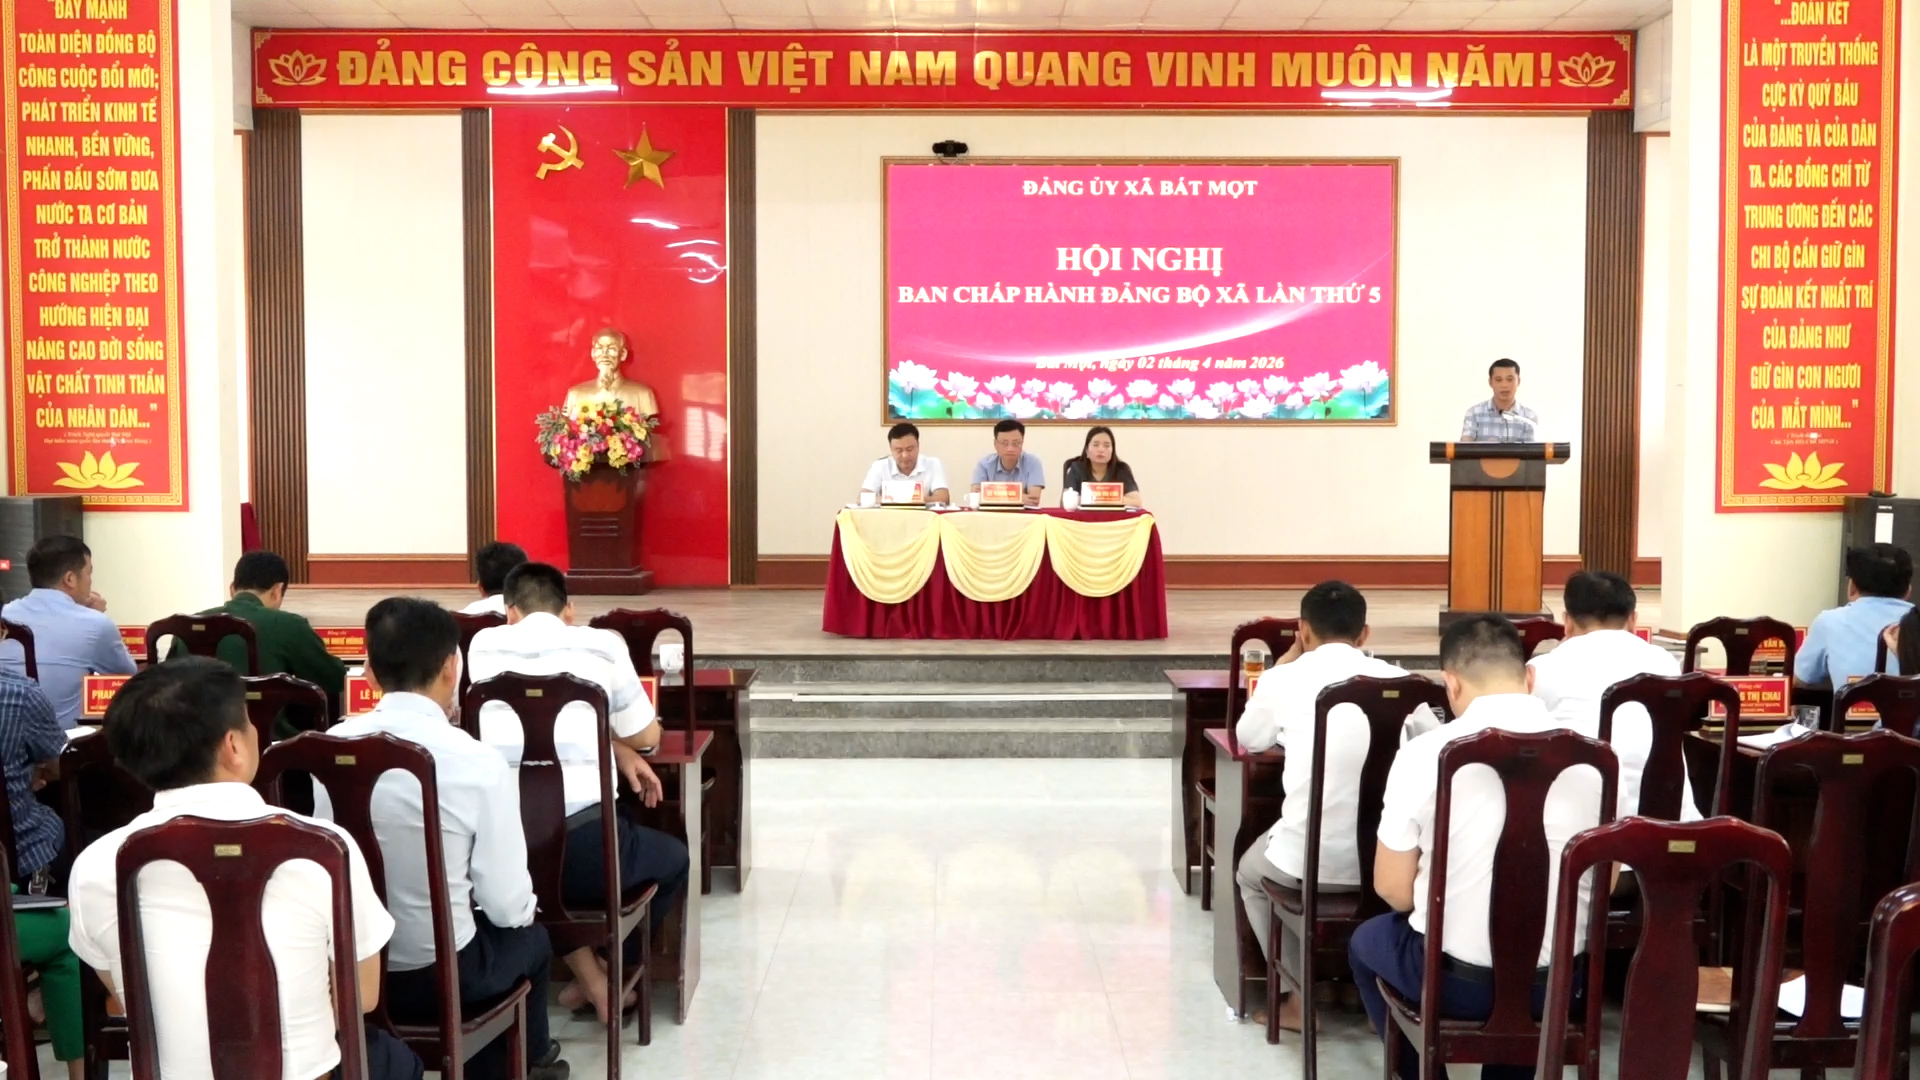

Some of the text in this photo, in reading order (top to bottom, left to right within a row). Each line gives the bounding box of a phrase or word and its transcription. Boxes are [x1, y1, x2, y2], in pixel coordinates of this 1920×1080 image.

[20, 30, 55, 53] TOÀN
[60, 30, 92, 57] DIỆN
[138, 30, 156, 57] BỘ
[1744, 38, 1758, 66] LÀ
[1762, 38, 1787, 71] MỘT
[1839, 34, 1878, 65] THỐNG
[19, 61, 158, 92] CÔNG CUỘC ĐỔI MỚI;
[336, 38, 468, 87] ĐẢNG
[485, 45, 613, 87] CÔNG
[627, 38, 724, 87] SẢN
[736, 42, 834, 94] VIỆT
[851, 50, 957, 86] NAM
[975, 51, 1132, 91] QUANG
[1146, 51, 1256, 87] VINH
[1271, 44, 1414, 87] MUÔN
[22, 95, 157, 122] PHÁT TRIỂN KINH TẾ
[1762, 78, 1858, 112] CỰC KỲ QUÝ BÁU
[26, 130, 154, 158] NHANH, BỀN VỮNG,
[1743, 116, 1876, 147] CỦA ĐẢNG VÀ CỦA DÂN
[23, 164, 159, 190] PHẤN ĐẤU SỚM ĐƯA
[1749, 157, 1871, 188] TA. CÁC ĐỒNG CHÍ TỪ
[1023, 176, 1258, 200] ĐẢNG ỦY XÃ BÁT MỌT
[36, 198, 147, 224] NƯỚC TA CƠ BẢN
[1744, 198, 1872, 228] TRUNG ƯƠNG ĐẾN CÁC
[34, 232, 150, 259] TRỞ THÀNH NƯỚC
[1751, 237, 1864, 274] CHI BỘ CẦN GIỮ GÌN
[1056, 244, 1224, 277] HỘI NGHỊ
[29, 269, 158, 297] CÔNG NGHIỆP THEO
[898, 282, 1380, 308] BAN CHẤP HÀNH ĐẢNG BỘ XÃ LẦN THỨ 5
[1742, 278, 1873, 314] SỰ ĐOÀN KẾT NHẤT TRÍ
[40, 303, 149, 331] HƯỚNG HIỆN ĐẠI
[27, 334, 164, 360] NÂNG CAO ĐỜI SỐNG
[1763, 318, 1851, 349] CỦA ĐẢNG NHƯ
[1100, 358, 1135, 372] ngày
[1137, 357, 1154, 369] 02
[1157, 357, 1200, 372] tháng
[1202, 357, 1212, 369] 4
[1214, 358, 1247, 369] năm
[1250, 357, 1284, 369] 2026
[1751, 362, 1771, 389] GIỮ
[1773, 361, 1794, 389] GÌN
[1797, 366, 1822, 389] CON
[27, 371, 52, 397] VẬT
[56, 368, 90, 394] CHẤT
[94, 374, 125, 394] TINH
[37, 402, 64, 427] CỦA
[68, 404, 106, 428] NHÂN
[1752, 398, 1775, 429] CỦA
[1782, 397, 1807, 428] MẮT
